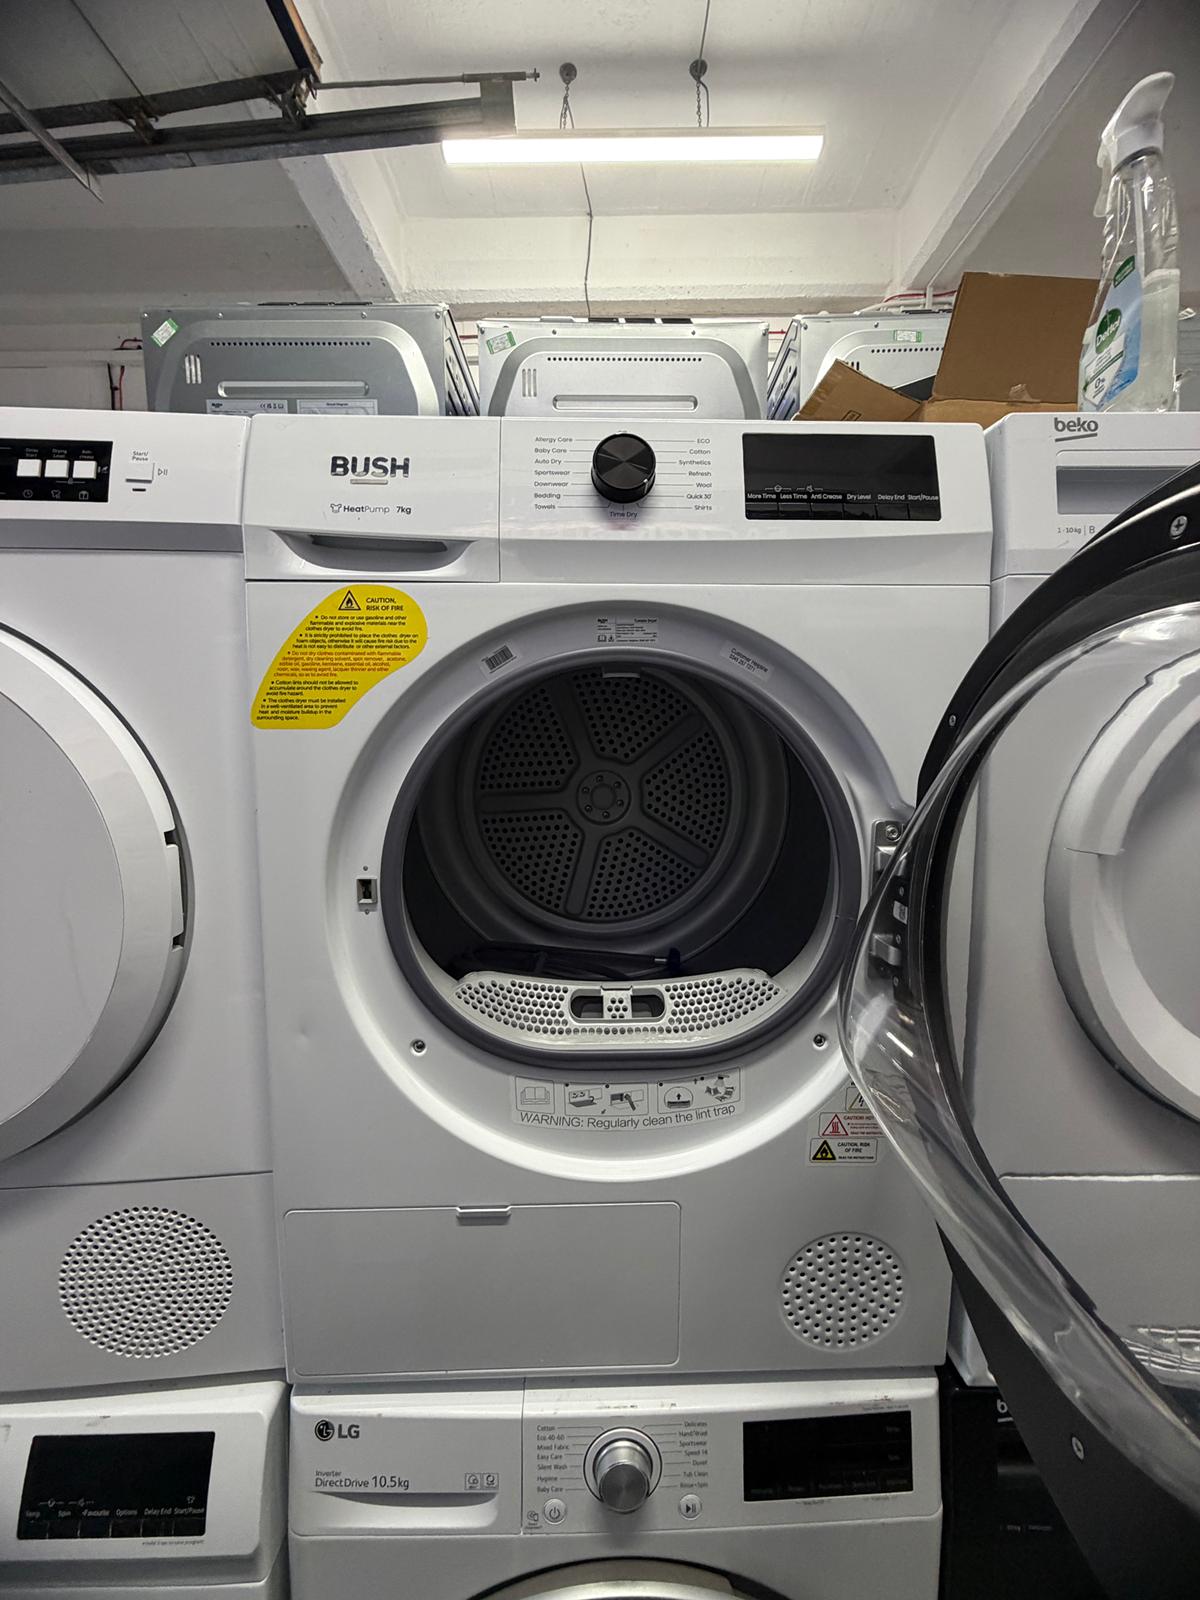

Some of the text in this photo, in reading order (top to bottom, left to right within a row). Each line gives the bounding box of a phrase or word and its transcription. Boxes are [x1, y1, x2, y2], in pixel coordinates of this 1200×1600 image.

[1054, 417, 1099, 432] beko
[331, 456, 410, 478] BUSH
[908, 493, 940, 501] Start/Pause
[343, 505, 412, 515] HeatPump 7kg
[626, 511, 638, 519] Dry
[521, 1103, 736, 1130] WARNING: Regularly clean the lint trap
[338, 1423, 360, 1439] LG
[315, 1475, 410, 1491] DirectDrive 10.5kg
